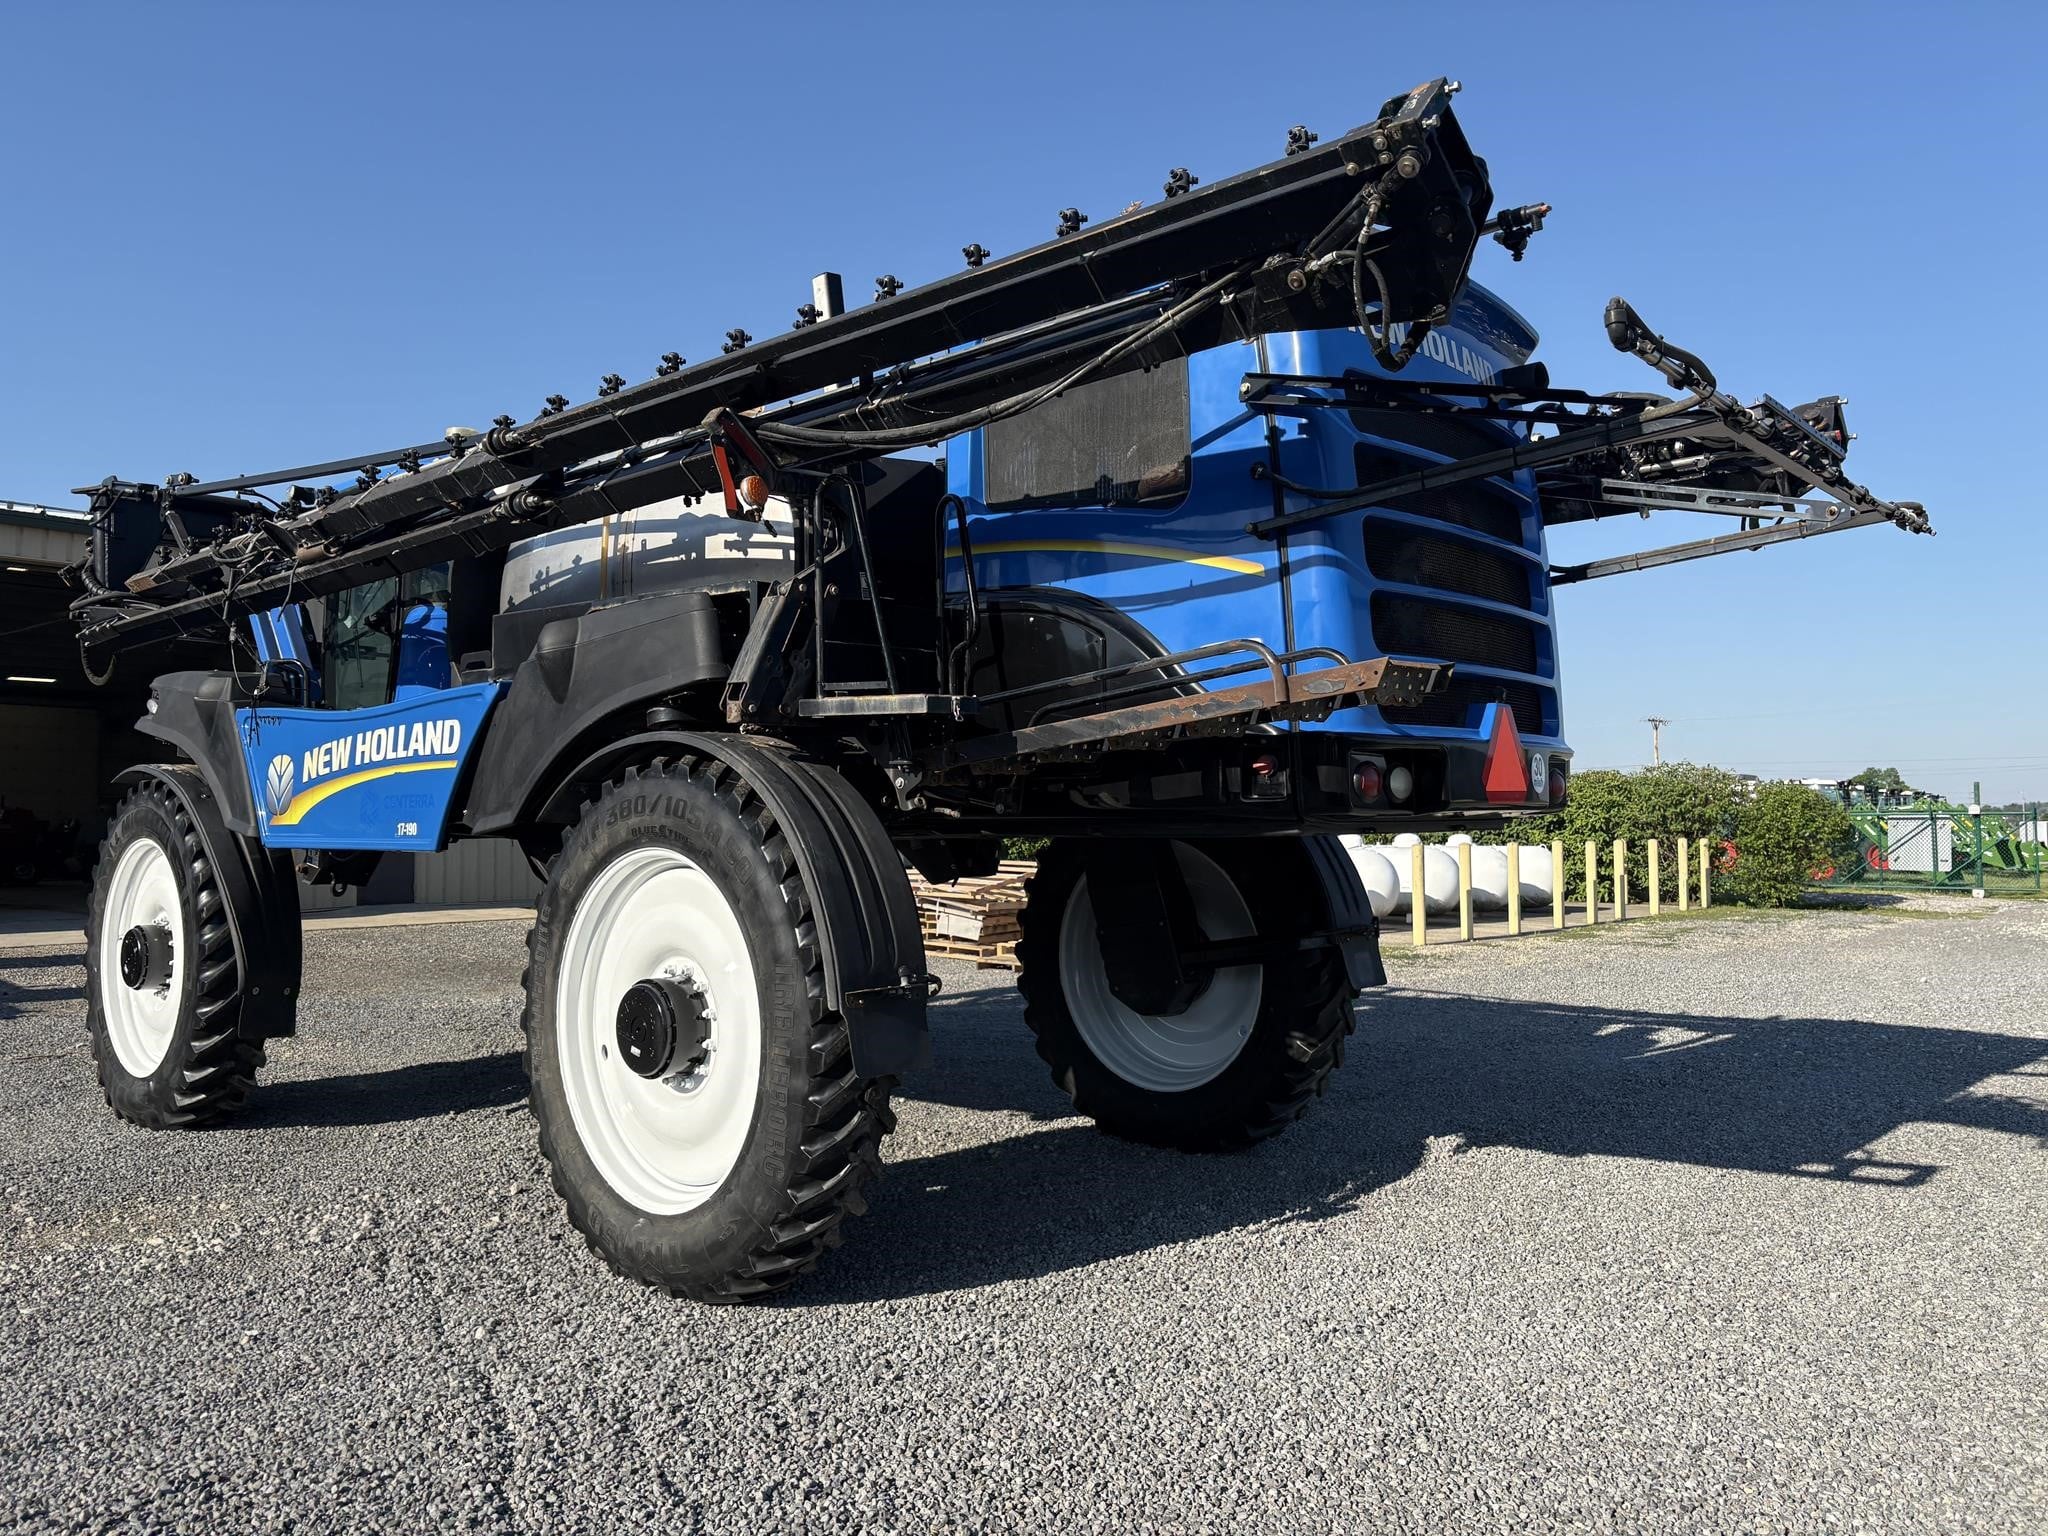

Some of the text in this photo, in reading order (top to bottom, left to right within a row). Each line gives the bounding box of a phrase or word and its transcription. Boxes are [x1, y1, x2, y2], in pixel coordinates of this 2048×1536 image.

[302, 720, 461, 783] NEW HOLLAND
[397, 822, 417, 836] 17-190
[764, 957, 799, 1179] TRELLEBORG
